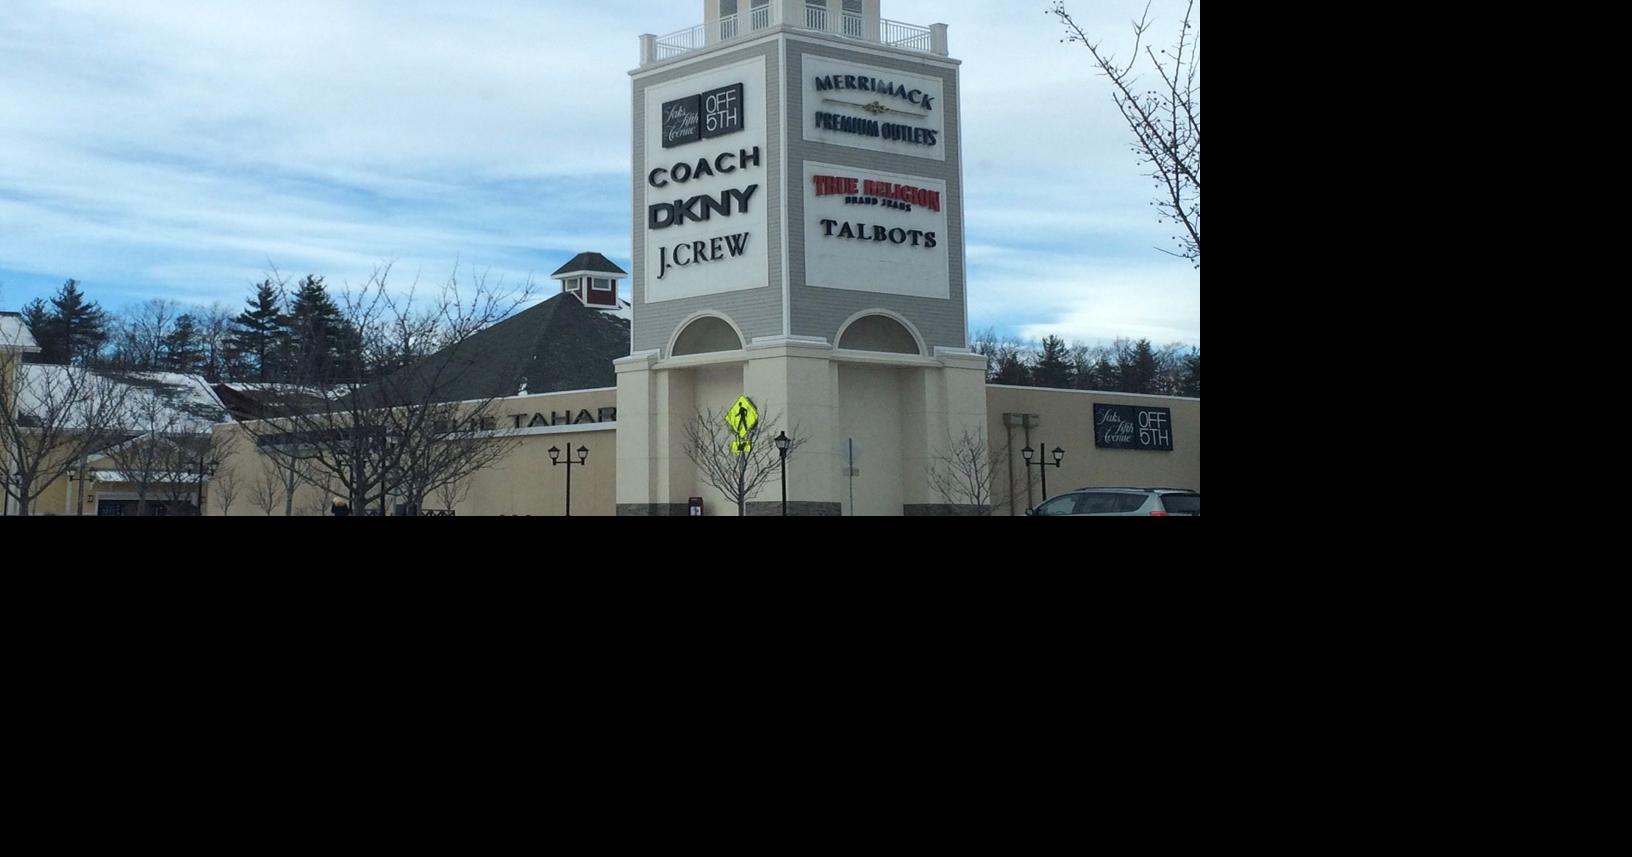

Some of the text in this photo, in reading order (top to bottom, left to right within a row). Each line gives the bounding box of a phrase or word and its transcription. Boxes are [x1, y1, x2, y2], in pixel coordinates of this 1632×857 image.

[706, 89, 737, 114] OFF
[815, 75, 935, 111] MERRIMACK
[706, 107, 737, 131] 5TH
[815, 111, 937, 146] PREMIUM OUTLETS
[648, 146, 760, 188] COACH
[648, 184, 758, 230] DKNY
[813, 175, 940, 212] TRUE RELIGION
[845, 196, 911, 212] BRAND JEANS
[820, 218, 937, 248] TALBOTS
[657, 232, 750, 279] J.CREW
[1138, 410, 1167, 429] OFF
[1139, 428, 1169, 446] 5TH
